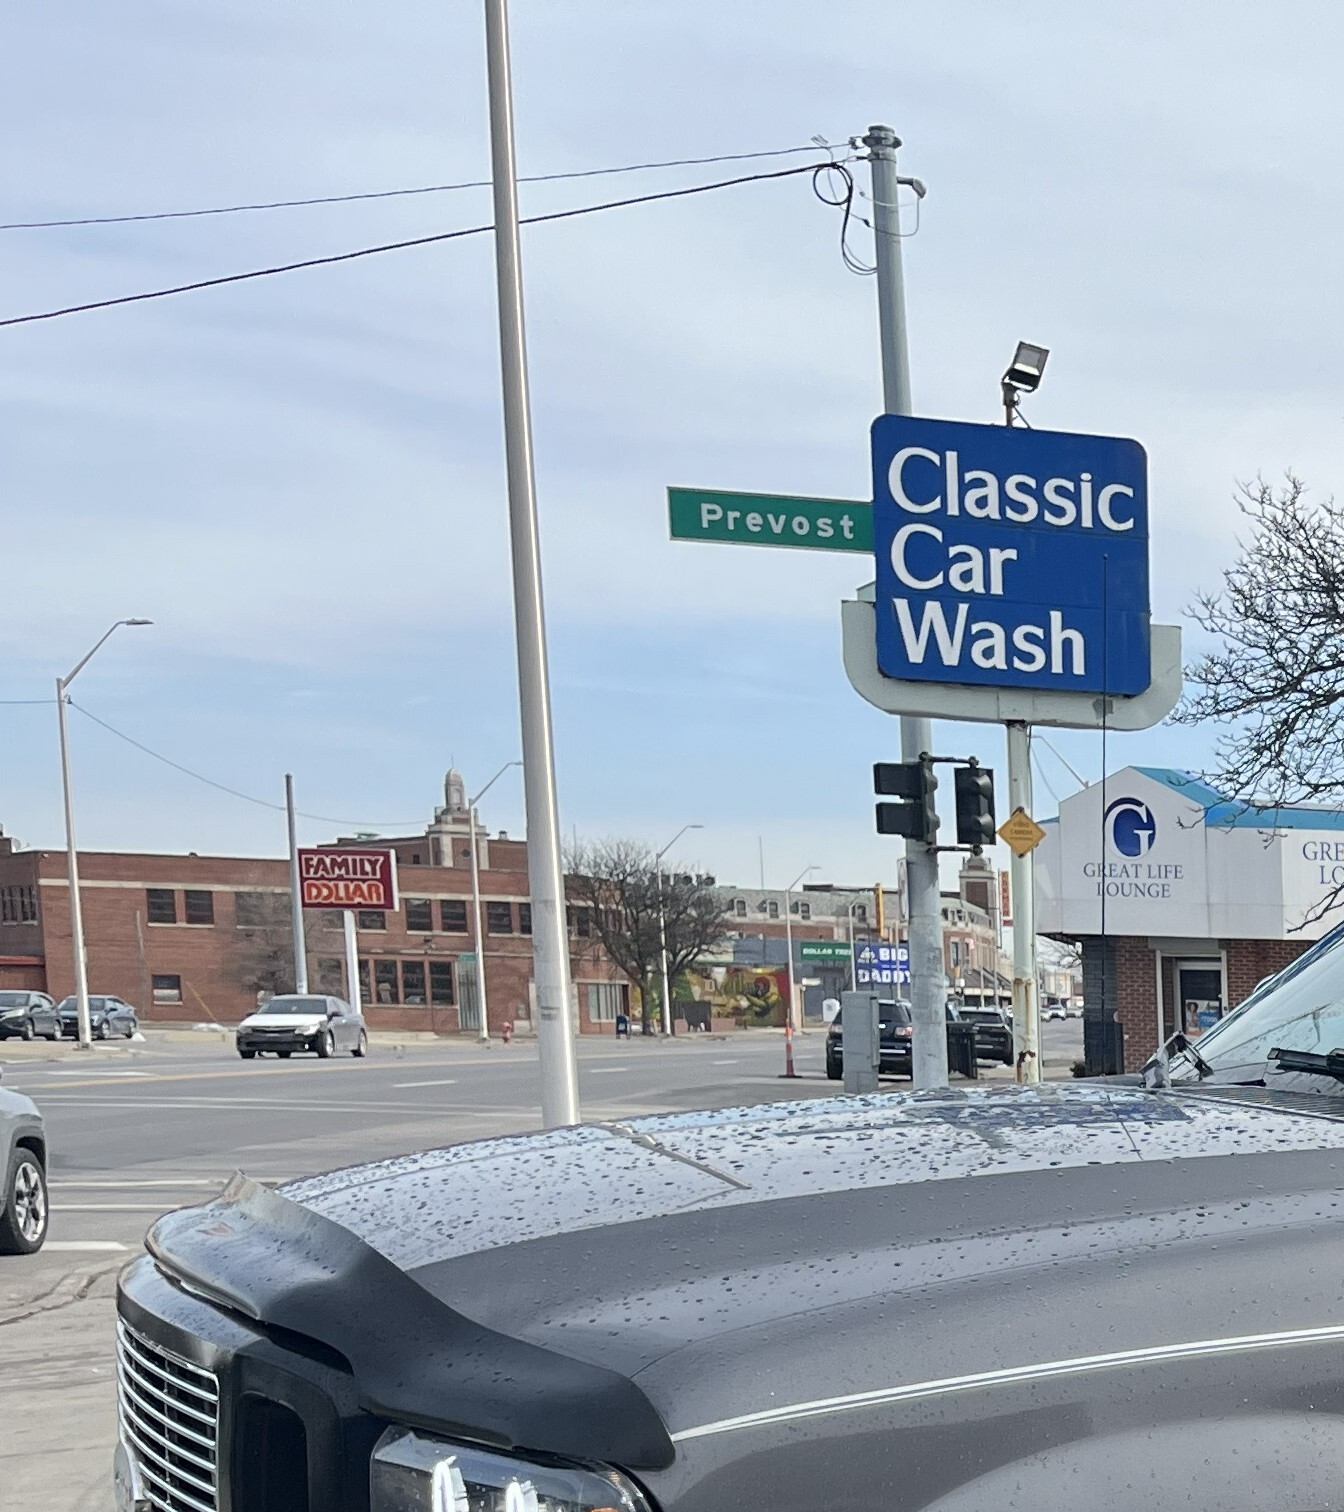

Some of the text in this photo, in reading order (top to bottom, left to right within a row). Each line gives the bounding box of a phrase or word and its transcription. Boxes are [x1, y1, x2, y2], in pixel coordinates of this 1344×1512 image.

[887, 446, 1135, 532] Classic
[700, 502, 855, 540] Prevost
[891, 523, 1018, 596] Car
[892, 598, 1086, 676] Wash
[1103, 803, 1154, 861] G
[301, 855, 384, 879] FAMILY
[1083, 862, 1184, 880] GREAT LIFE
[304, 880, 384, 904] DOLLAR
[1096, 881, 1172, 899] LOUNGE
[879, 947, 908, 961] BIG
